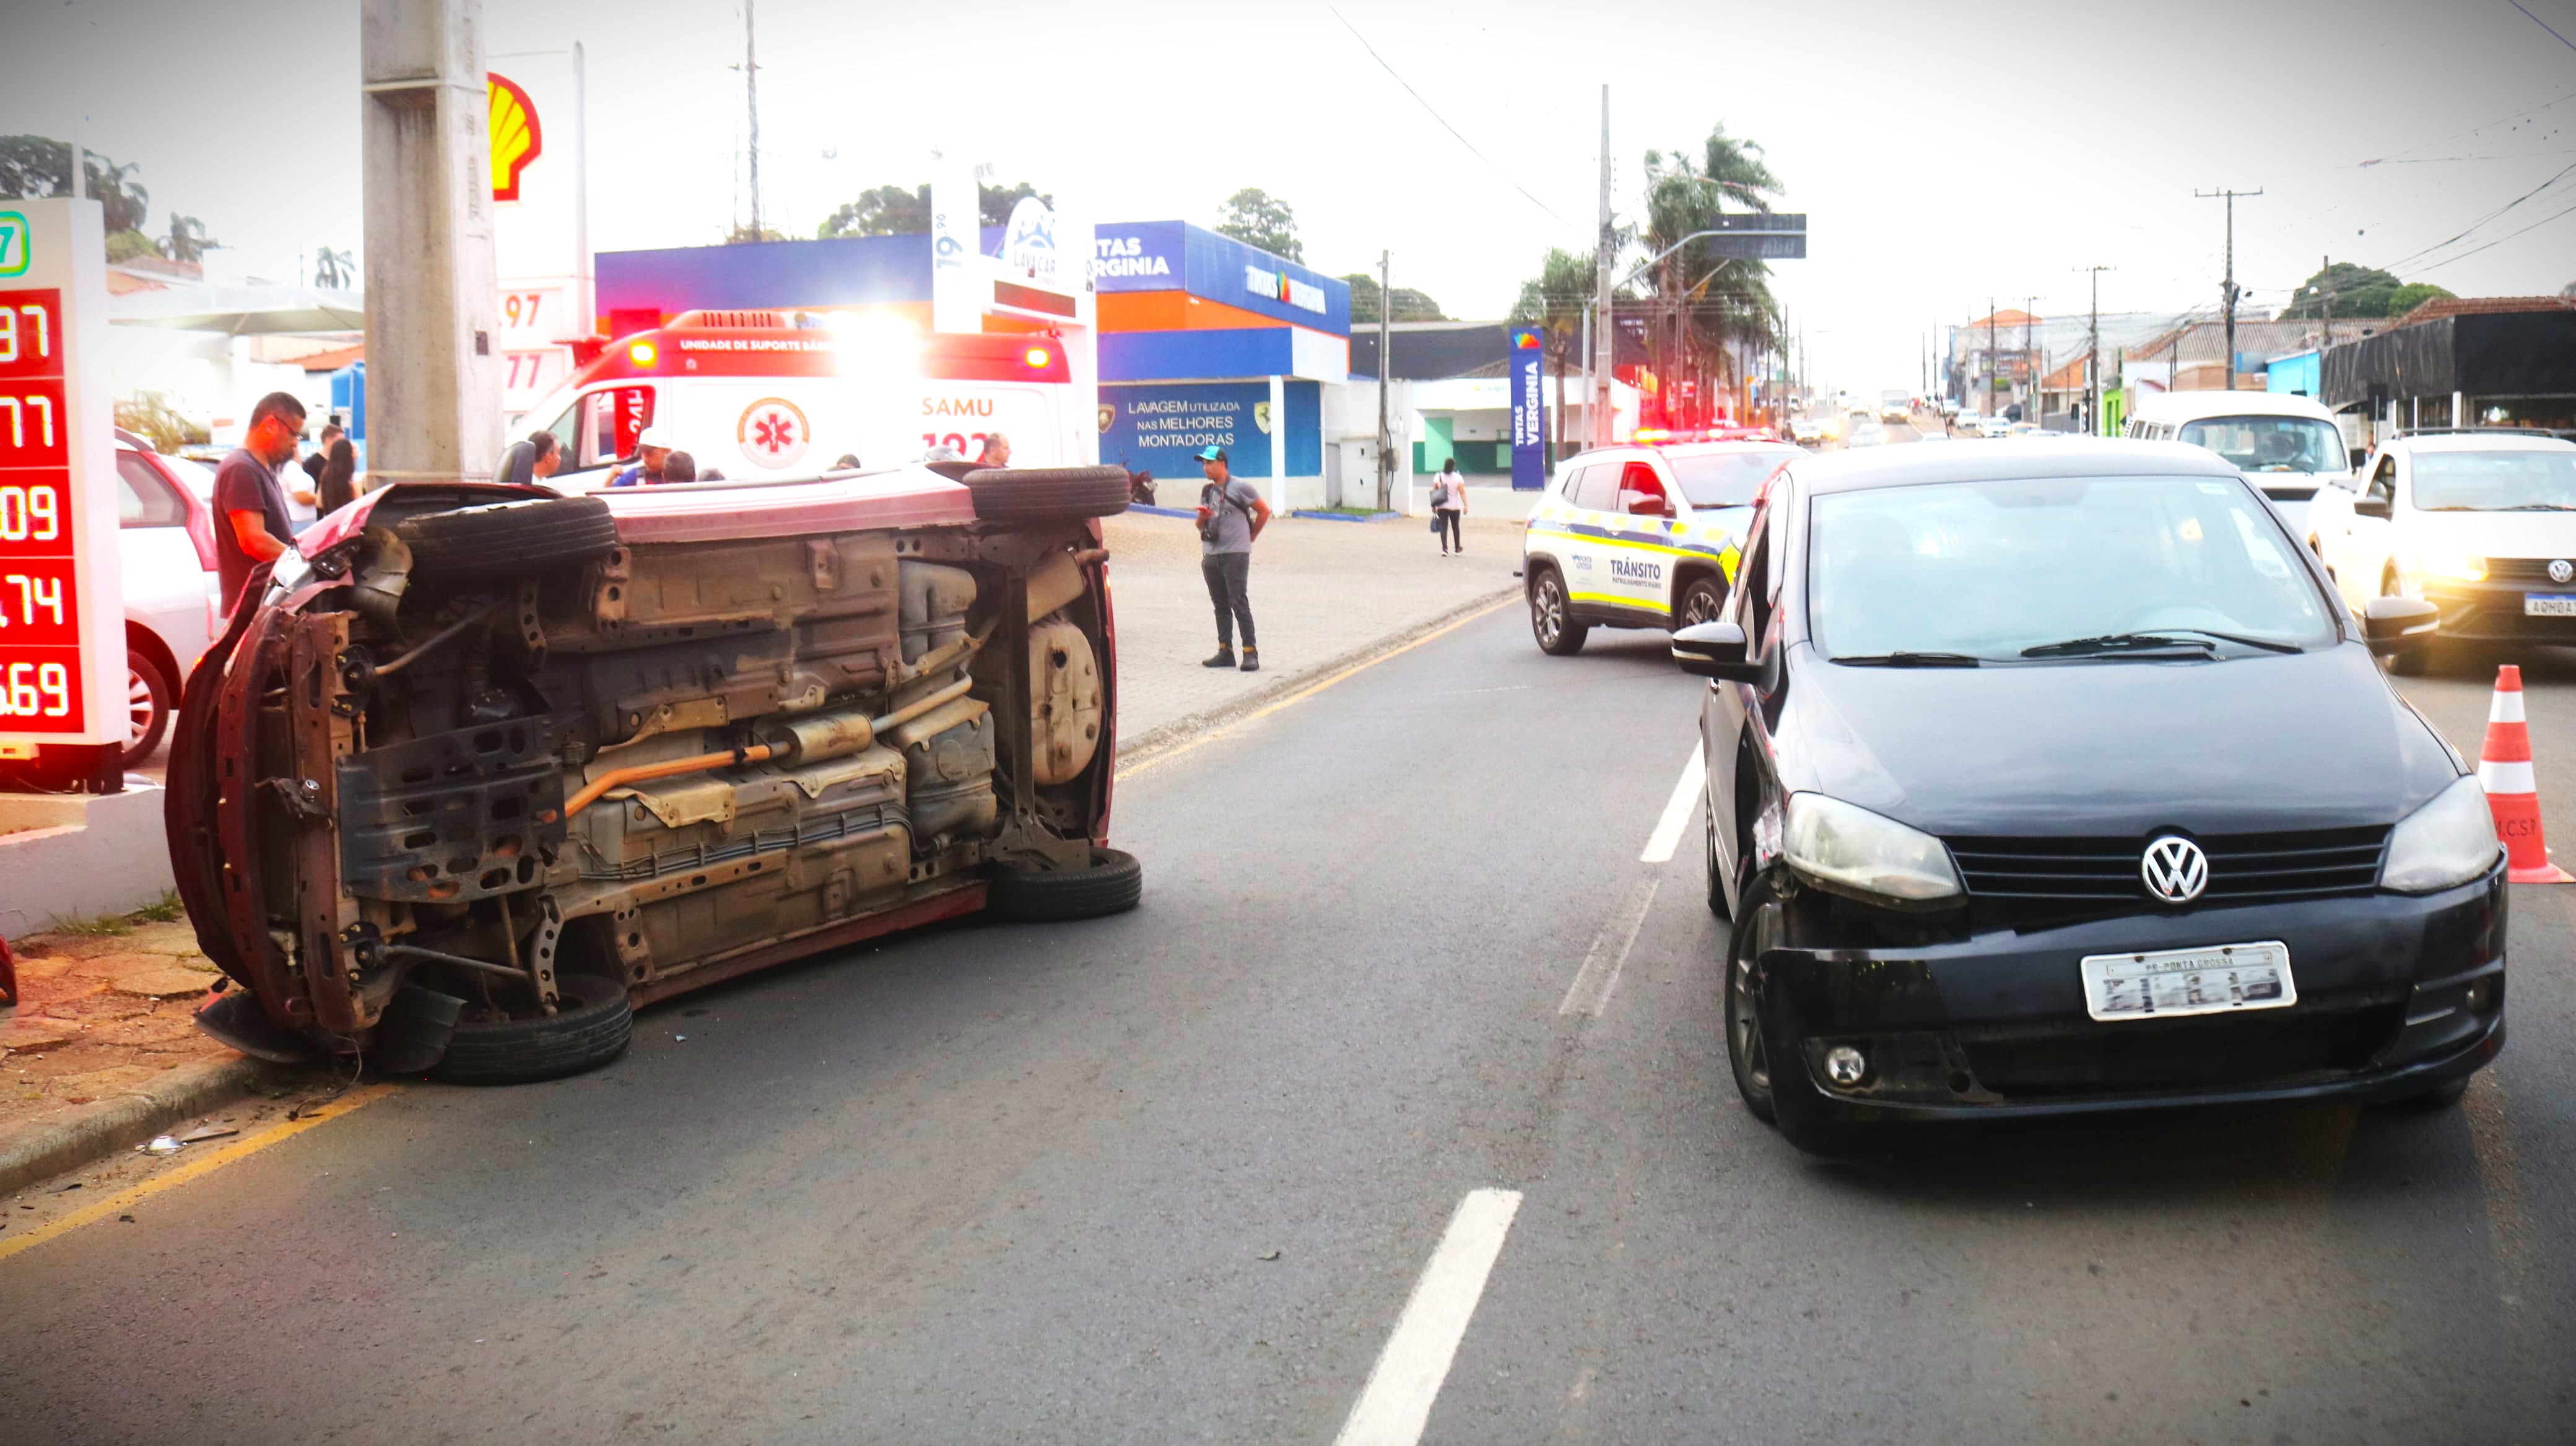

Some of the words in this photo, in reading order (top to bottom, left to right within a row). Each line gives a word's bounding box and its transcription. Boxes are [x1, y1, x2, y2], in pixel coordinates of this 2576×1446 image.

[681, 339, 731, 351] UNIDADE
[734, 341, 747, 351] DE
[750, 340, 801, 351] SUPORTE
[922, 398, 993, 416] SAMU
[1128, 401, 1188, 414] LAVAGEM
[1189, 402, 1240, 412] UTILIZADA
[1526, 361, 1539, 446] VERGINIA
[1137, 421, 1157, 431] NAS
[1159, 416, 1233, 430] MELHORES
[1515, 406, 1525, 446] TINTAS
[1138, 433, 1234, 448] MONTADORAS
[1611, 557, 1660, 578] TRÂNSITO
